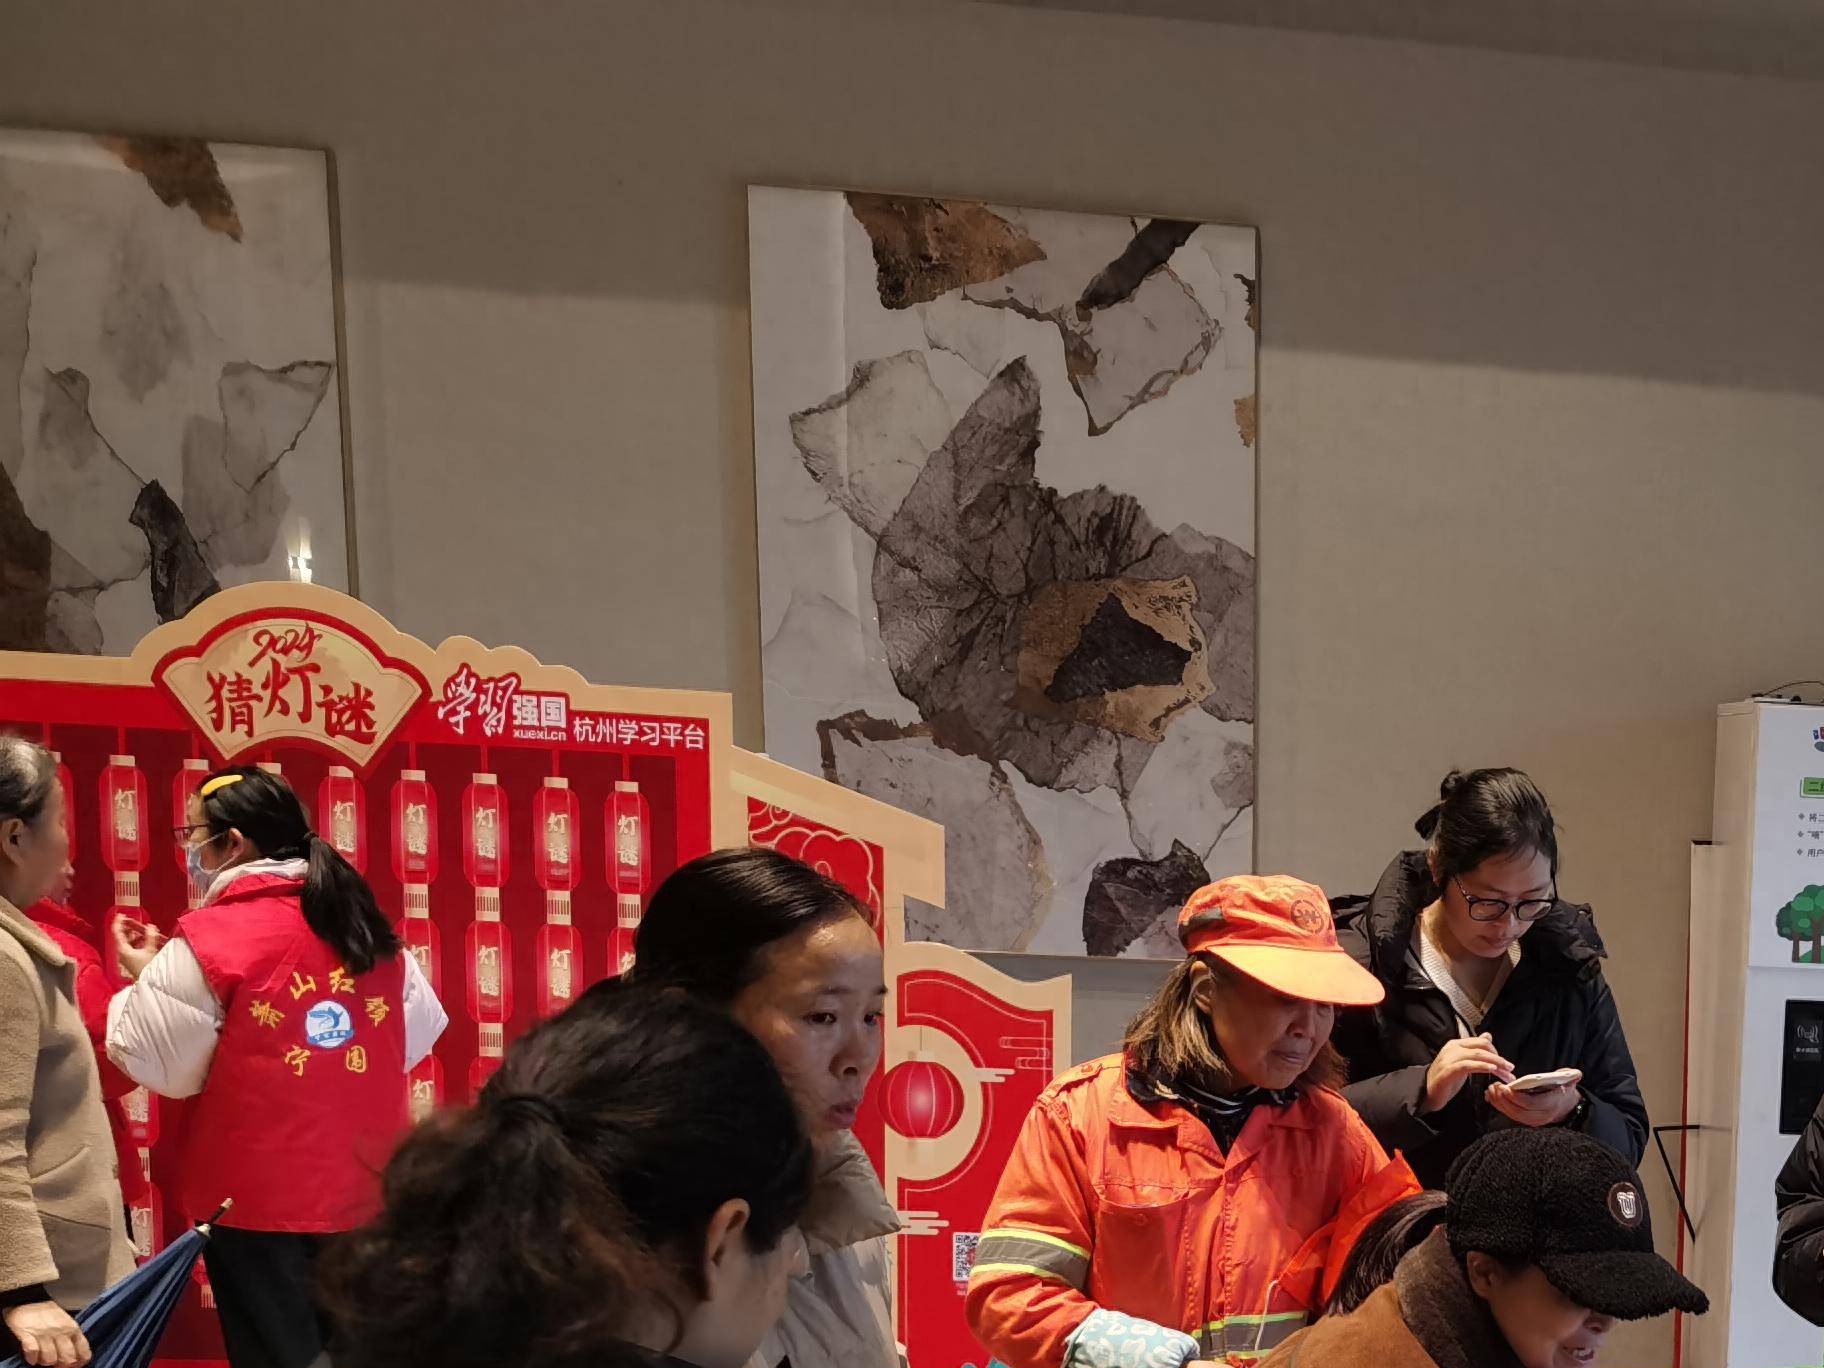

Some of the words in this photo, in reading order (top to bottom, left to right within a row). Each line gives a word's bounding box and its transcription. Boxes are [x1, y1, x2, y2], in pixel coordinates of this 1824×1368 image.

[248, 622, 323, 667] 2024
[205, 657, 378, 745] 猜灯谜
[513, 727, 567, 741] xuexi.cn
[573, 717, 705, 749] 杭州学习平台
[405, 802, 428, 855] 灯谜
[476, 806, 497, 859] 灯谜
[547, 812, 569, 864] 灯谜
[617, 814, 640, 866] 灯谜
[477, 944, 500, 997] 灯谜
[550, 947, 572, 999] 灯谜
